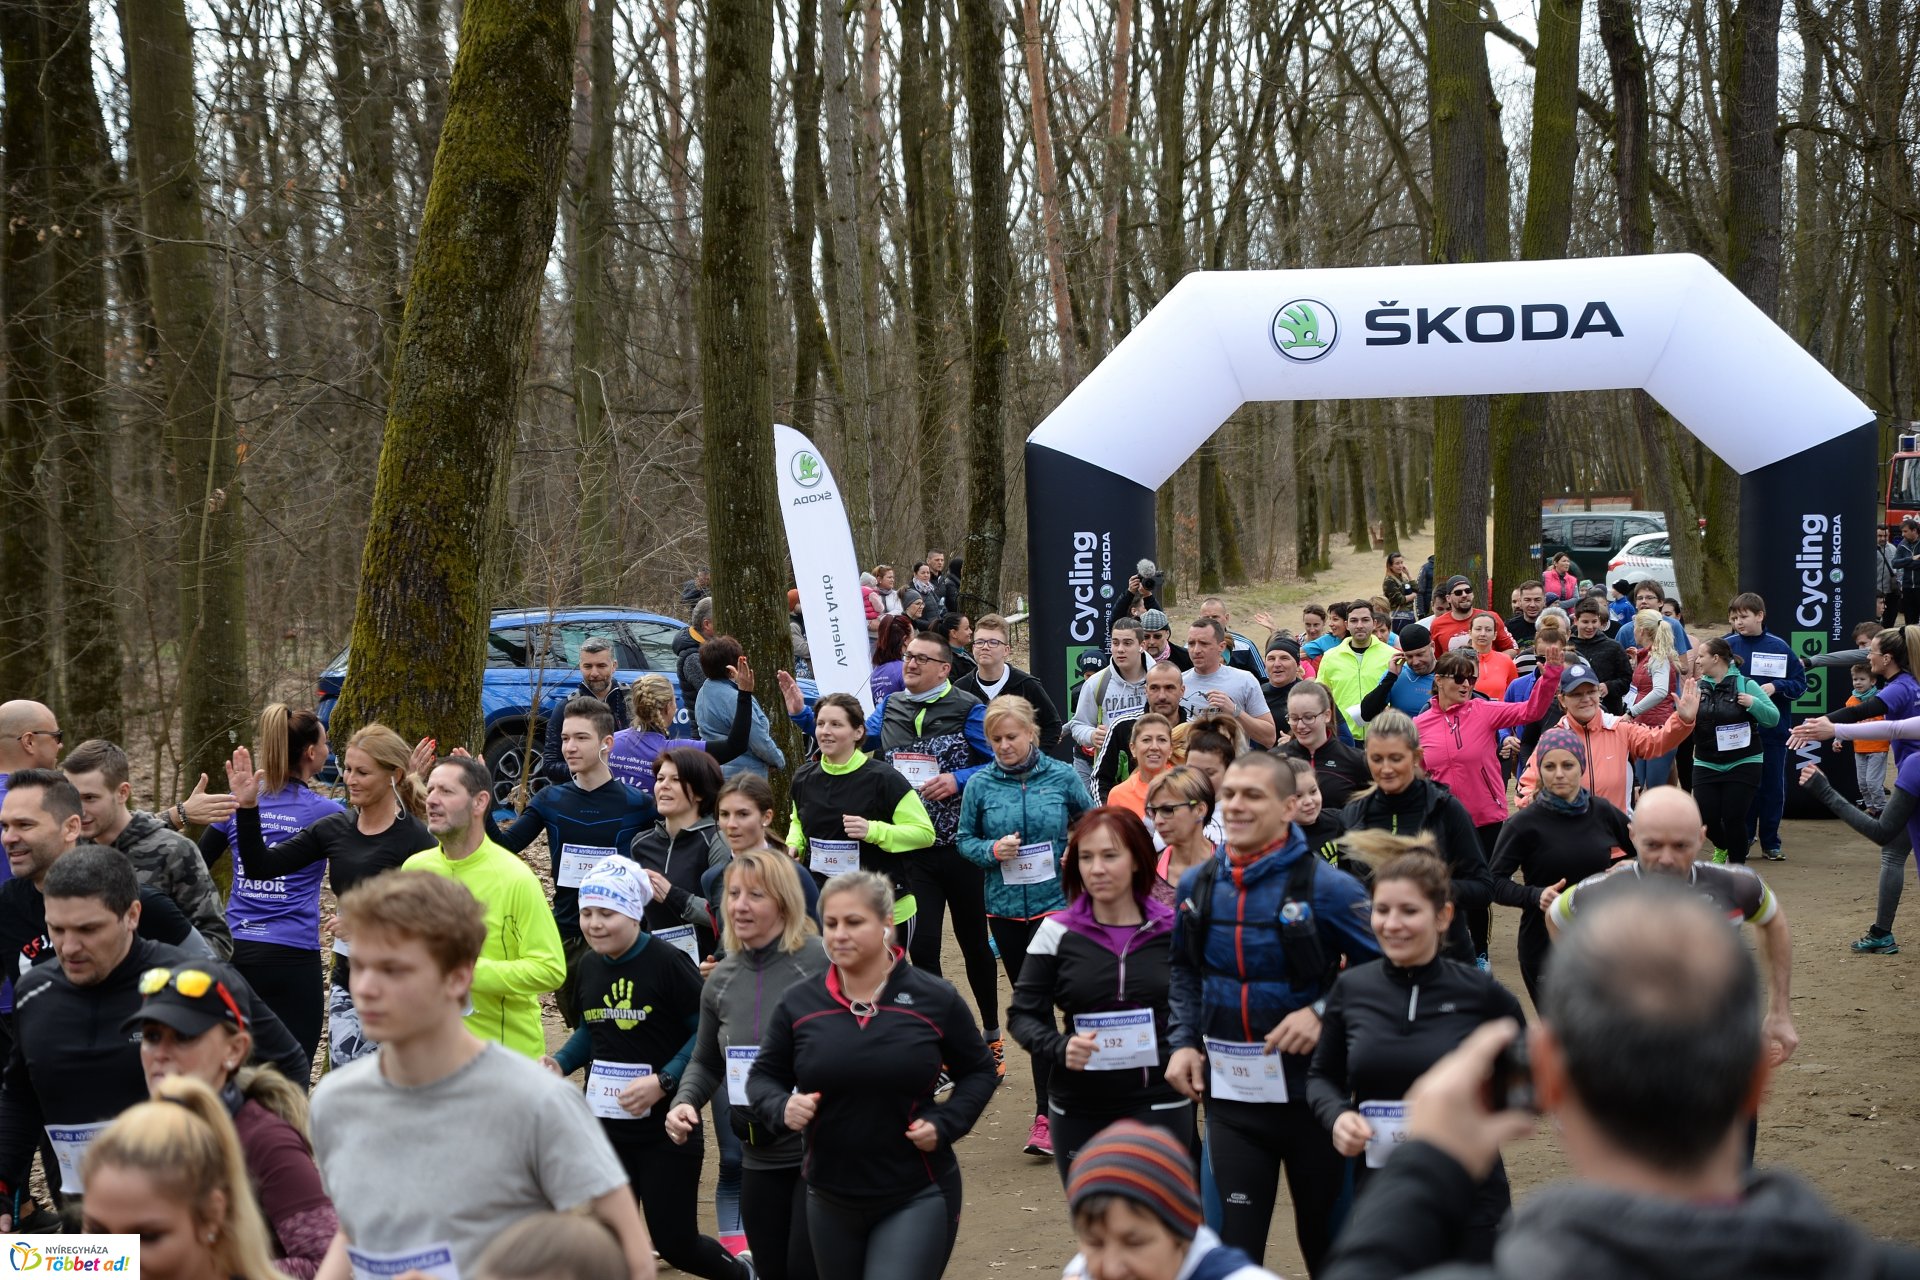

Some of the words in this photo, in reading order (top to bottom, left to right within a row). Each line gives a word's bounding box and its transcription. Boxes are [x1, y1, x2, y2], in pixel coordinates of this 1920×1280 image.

[1365, 300, 1625, 346] ŠKODA
[1831, 514, 1841, 565] ŠKODA
[1101, 531, 1111, 581] ŠKODA
[1795, 514, 1828, 627] Cycling
[1068, 531, 1099, 642] Cycling
[578, 862, 593, 871] 179
[1018, 863, 1033, 871] 342
[1103, 1038, 1123, 1048] 192
[1232, 1066, 1250, 1077] 191
[603, 1086, 621, 1097] 210
